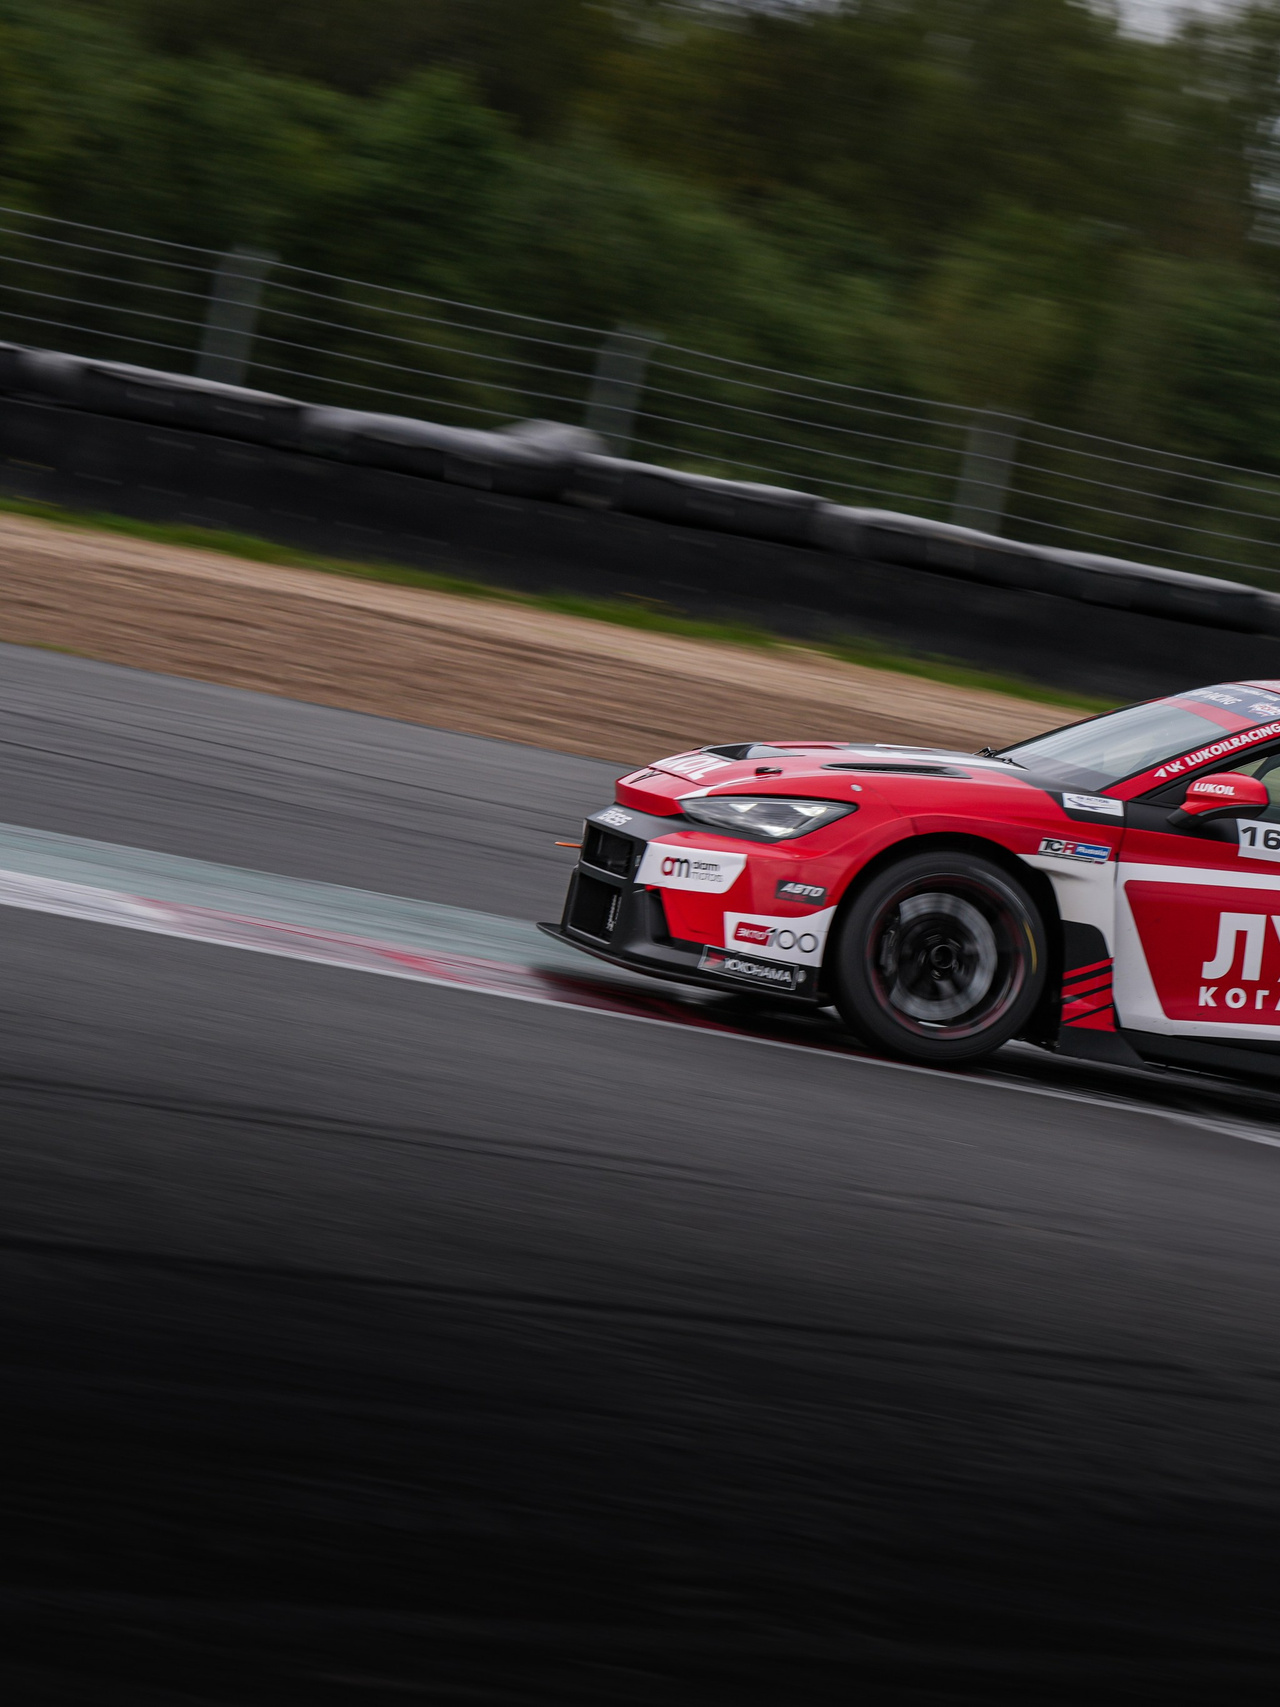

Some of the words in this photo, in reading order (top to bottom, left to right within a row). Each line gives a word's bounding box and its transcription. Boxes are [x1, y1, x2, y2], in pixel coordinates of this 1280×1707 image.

[1193, 782, 1235, 796] LUKOIL
[1042, 838, 1077, 855] TCR
[780, 882, 825, 898] АВТО
[766, 927, 819, 953] 100
[724, 957, 792, 983] YOKOHAMA
